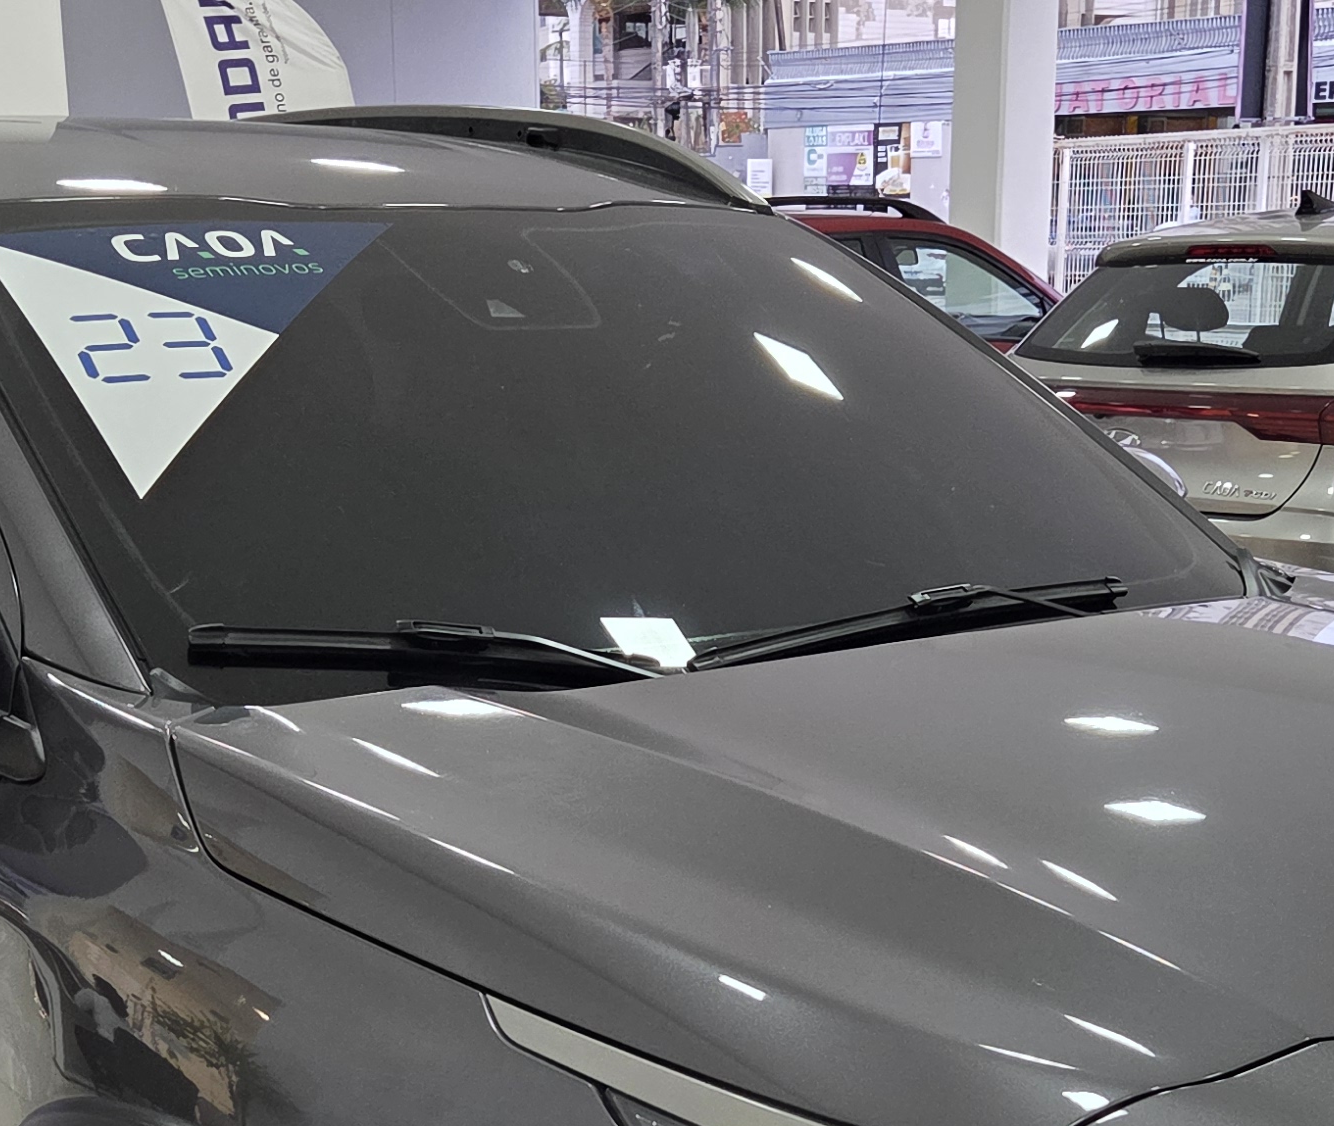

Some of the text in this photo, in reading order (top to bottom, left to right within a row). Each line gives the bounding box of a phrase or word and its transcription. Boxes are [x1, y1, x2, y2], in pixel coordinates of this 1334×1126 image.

[268, 68, 282, 88] de
[110, 229, 310, 263] CAOA
[172, 260, 325, 280] seminovos
[69, 311, 234, 384] 23
